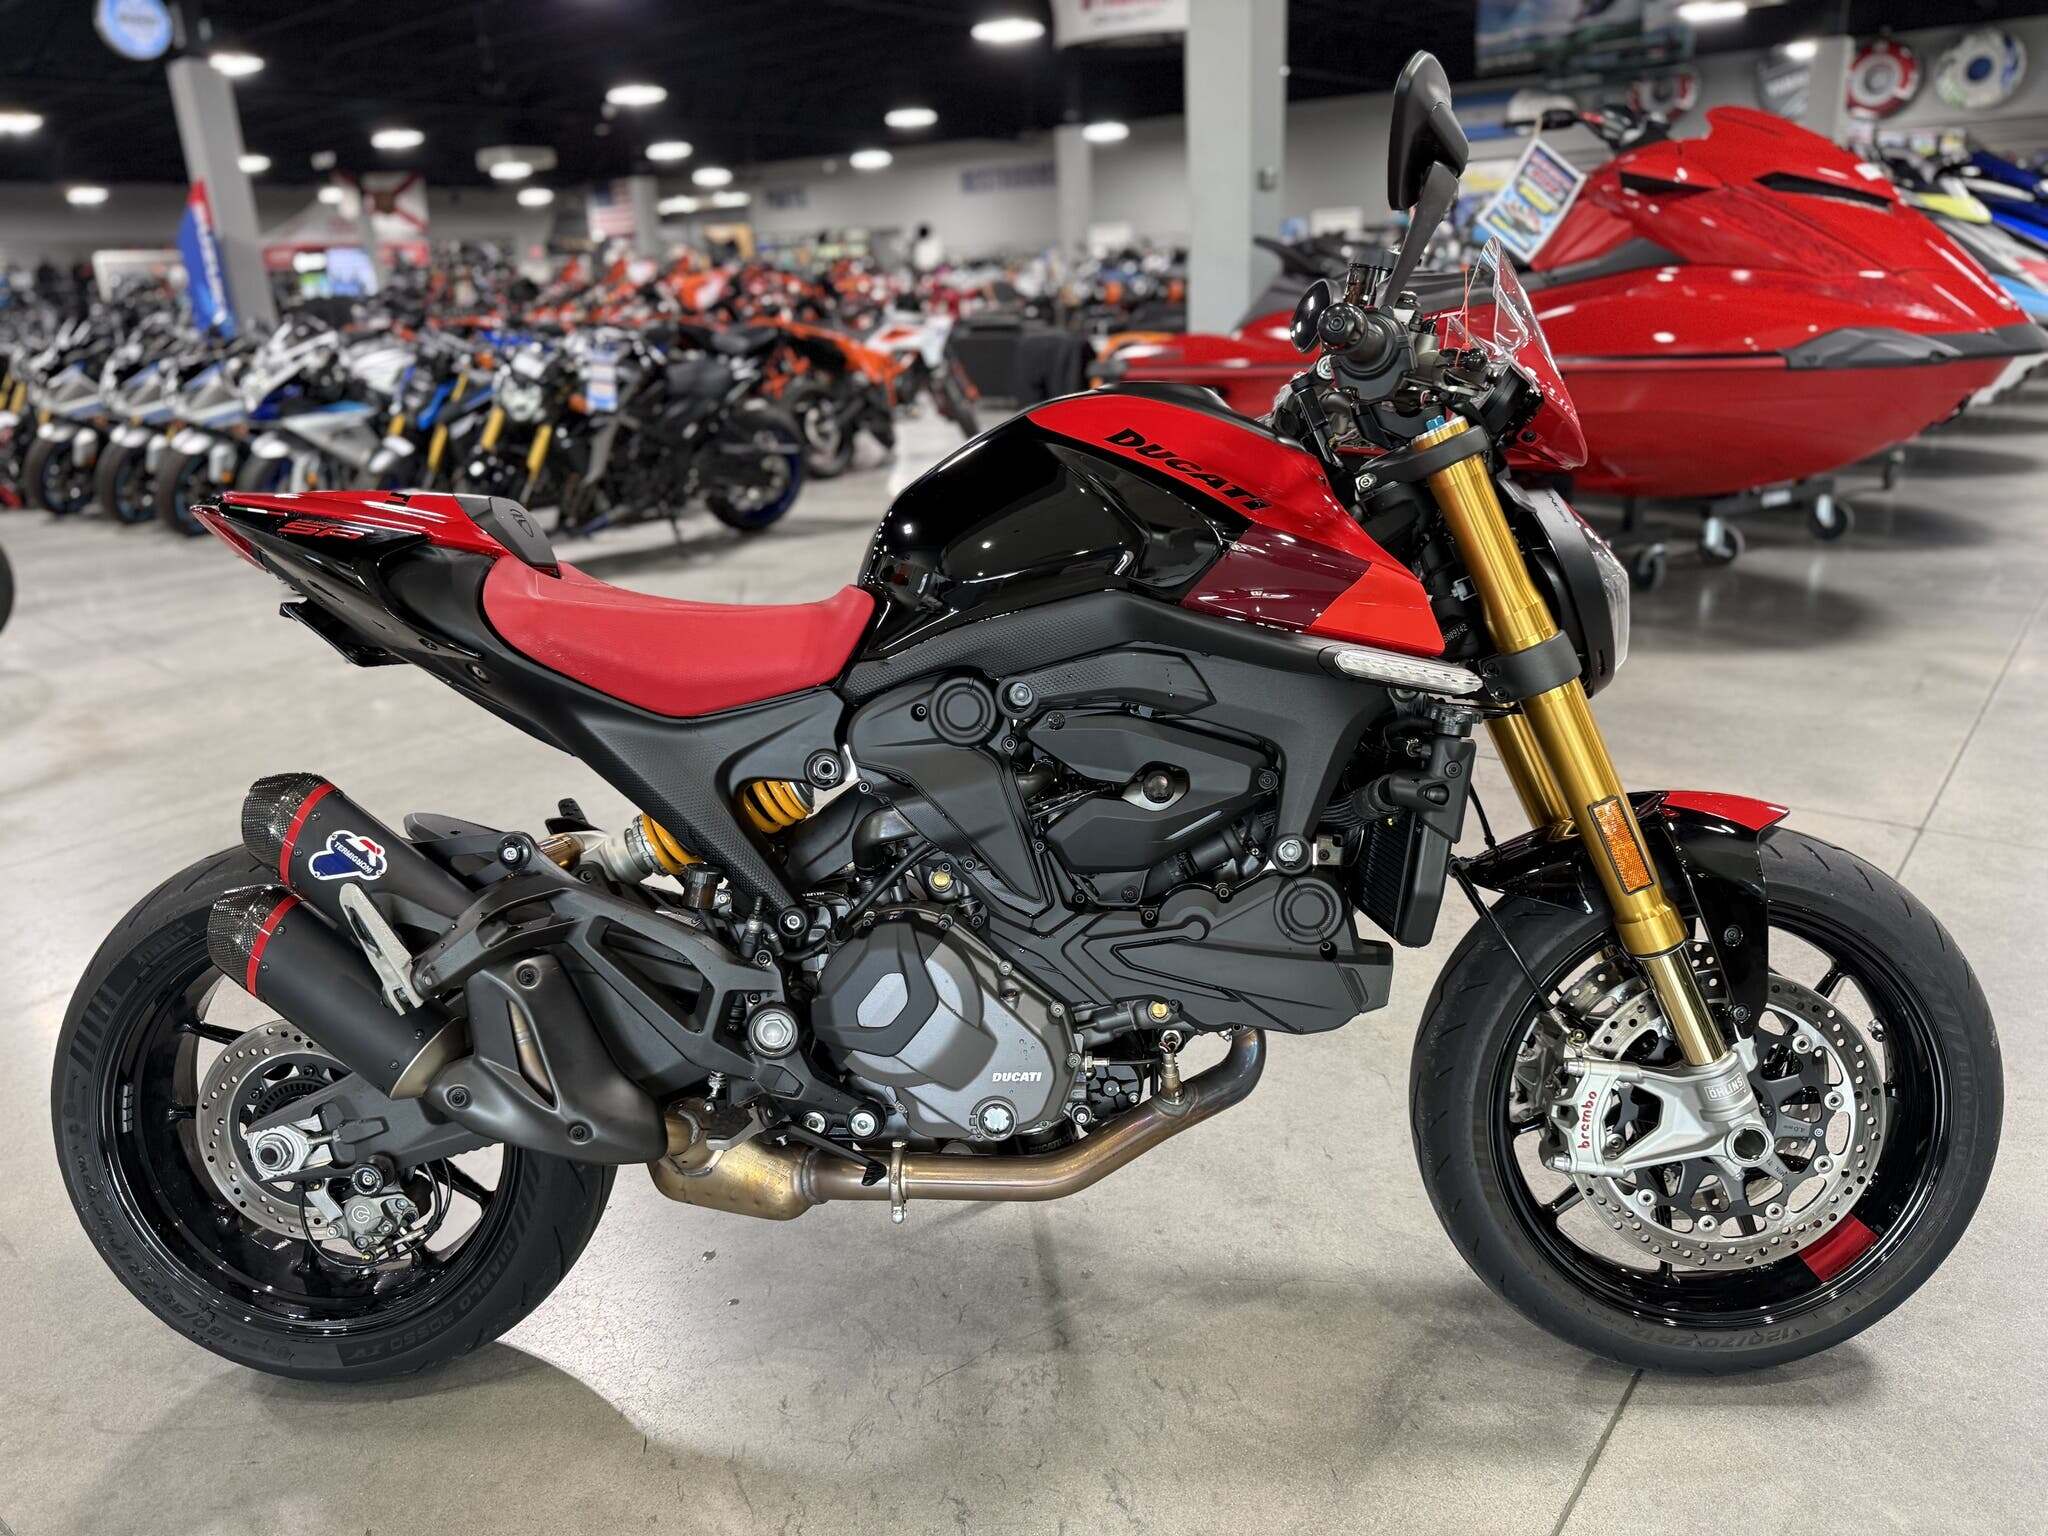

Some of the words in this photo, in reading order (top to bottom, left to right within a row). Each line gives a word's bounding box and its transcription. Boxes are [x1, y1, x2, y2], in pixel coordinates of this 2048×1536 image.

[1104, 428, 1272, 510] DUCATI
[334, 841, 374, 874] TERMIGNONI
[992, 1071, 1042, 1082] DUCATI
[1708, 1076, 1744, 1099] ÖHLINS
[1578, 1090, 1598, 1150] brembo
